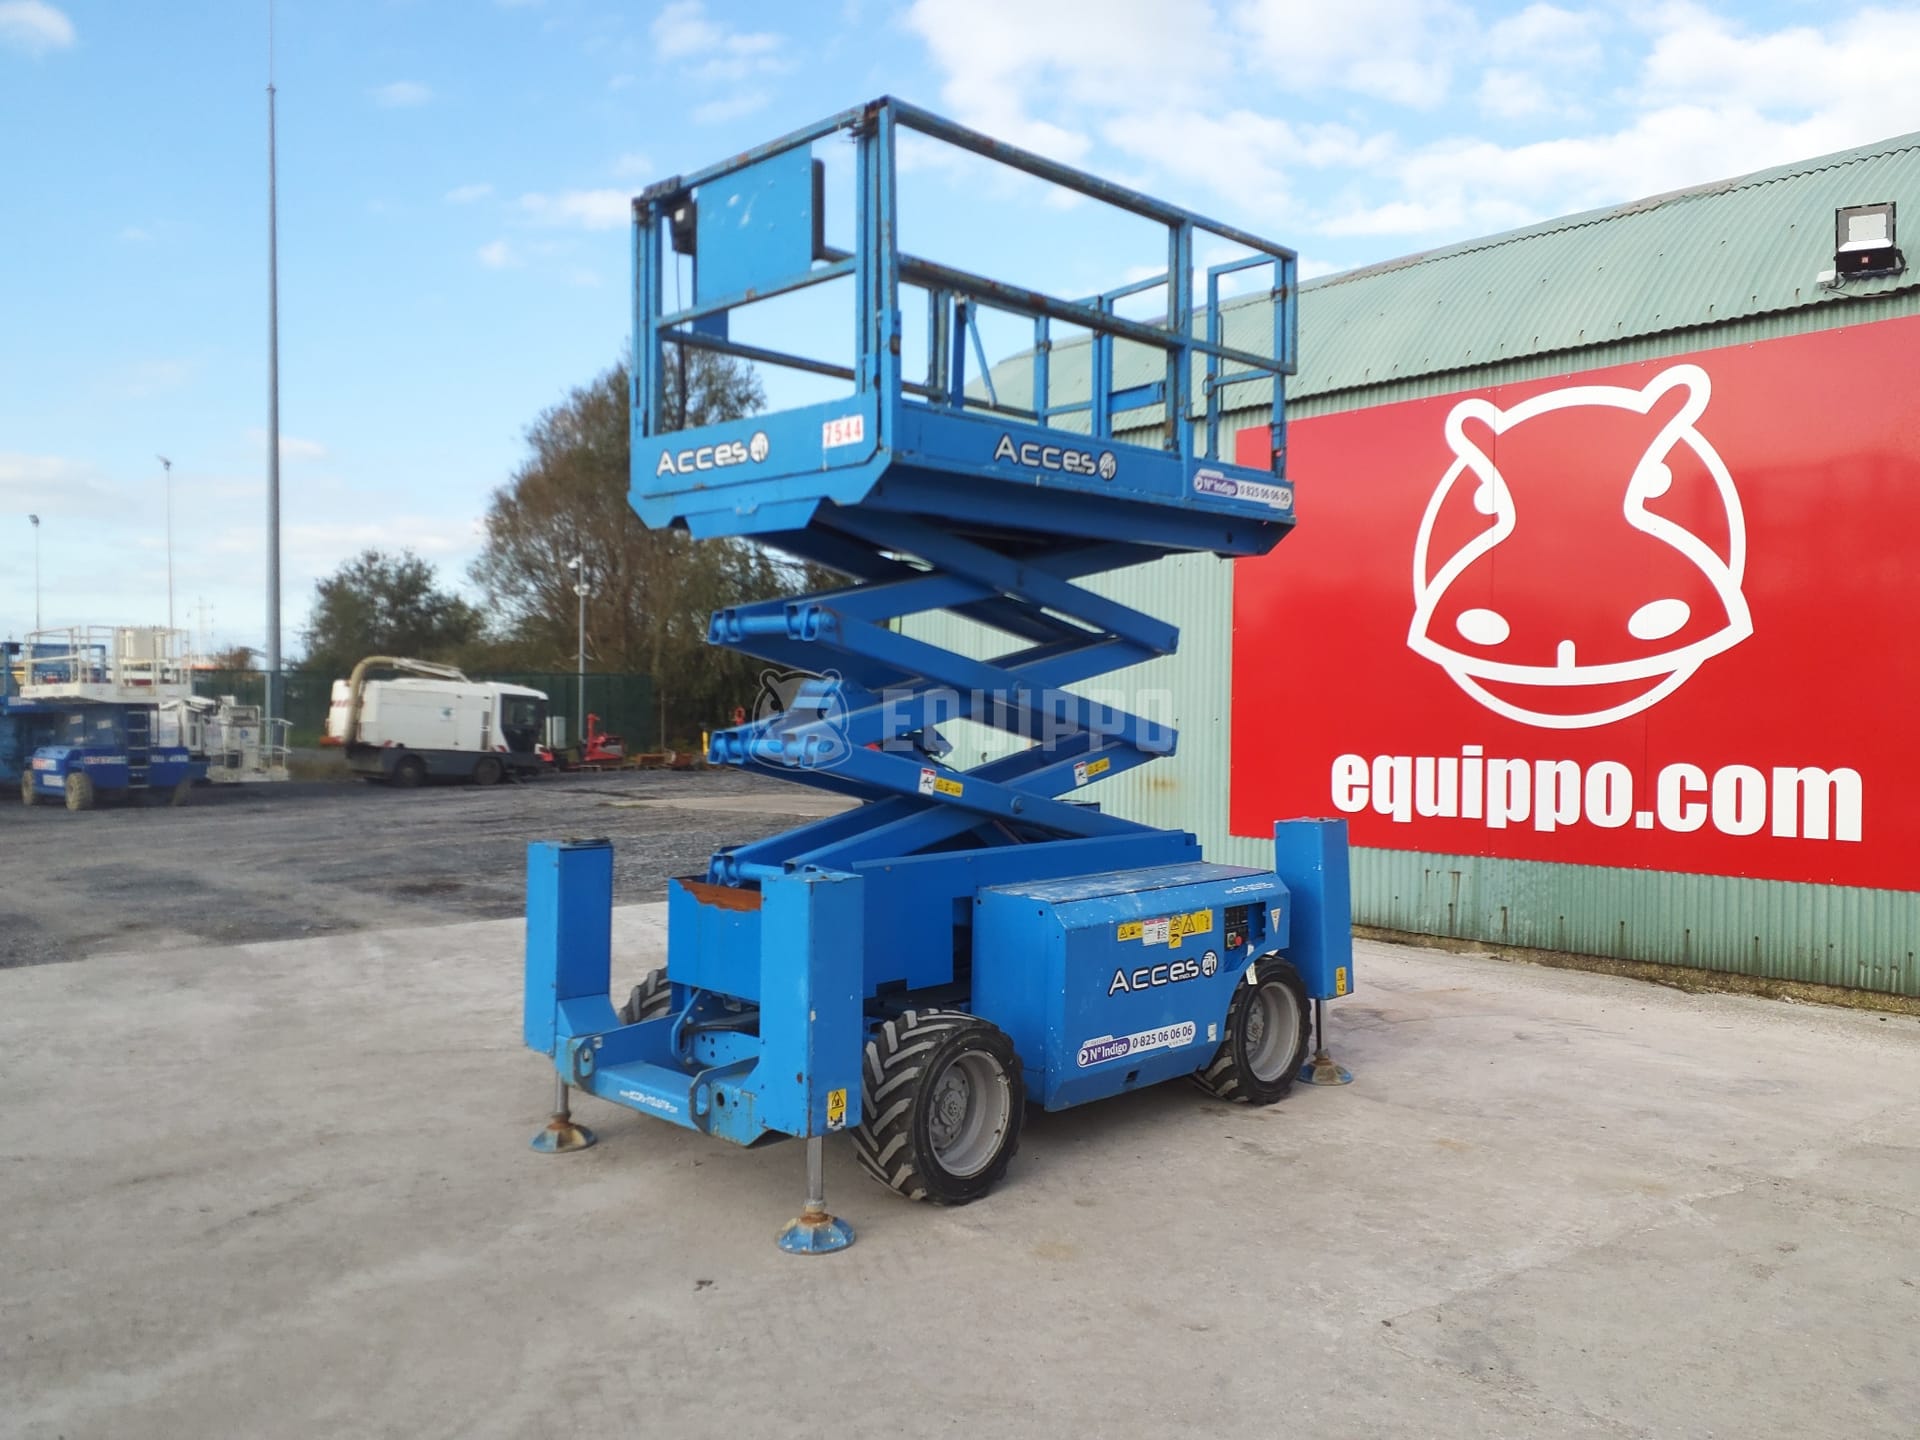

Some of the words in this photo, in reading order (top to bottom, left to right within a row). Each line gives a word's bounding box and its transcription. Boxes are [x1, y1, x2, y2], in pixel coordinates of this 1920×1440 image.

[825, 419, 862, 445] 7544
[1331, 744, 1863, 842] equippo.com
[1132, 1038, 1139, 1049] 0
[1140, 1034, 1156, 1047] 825
[1158, 1031, 1169, 1043] 06
[1170, 1028, 1181, 1040] 06
[1182, 1025, 1193, 1037] 06
